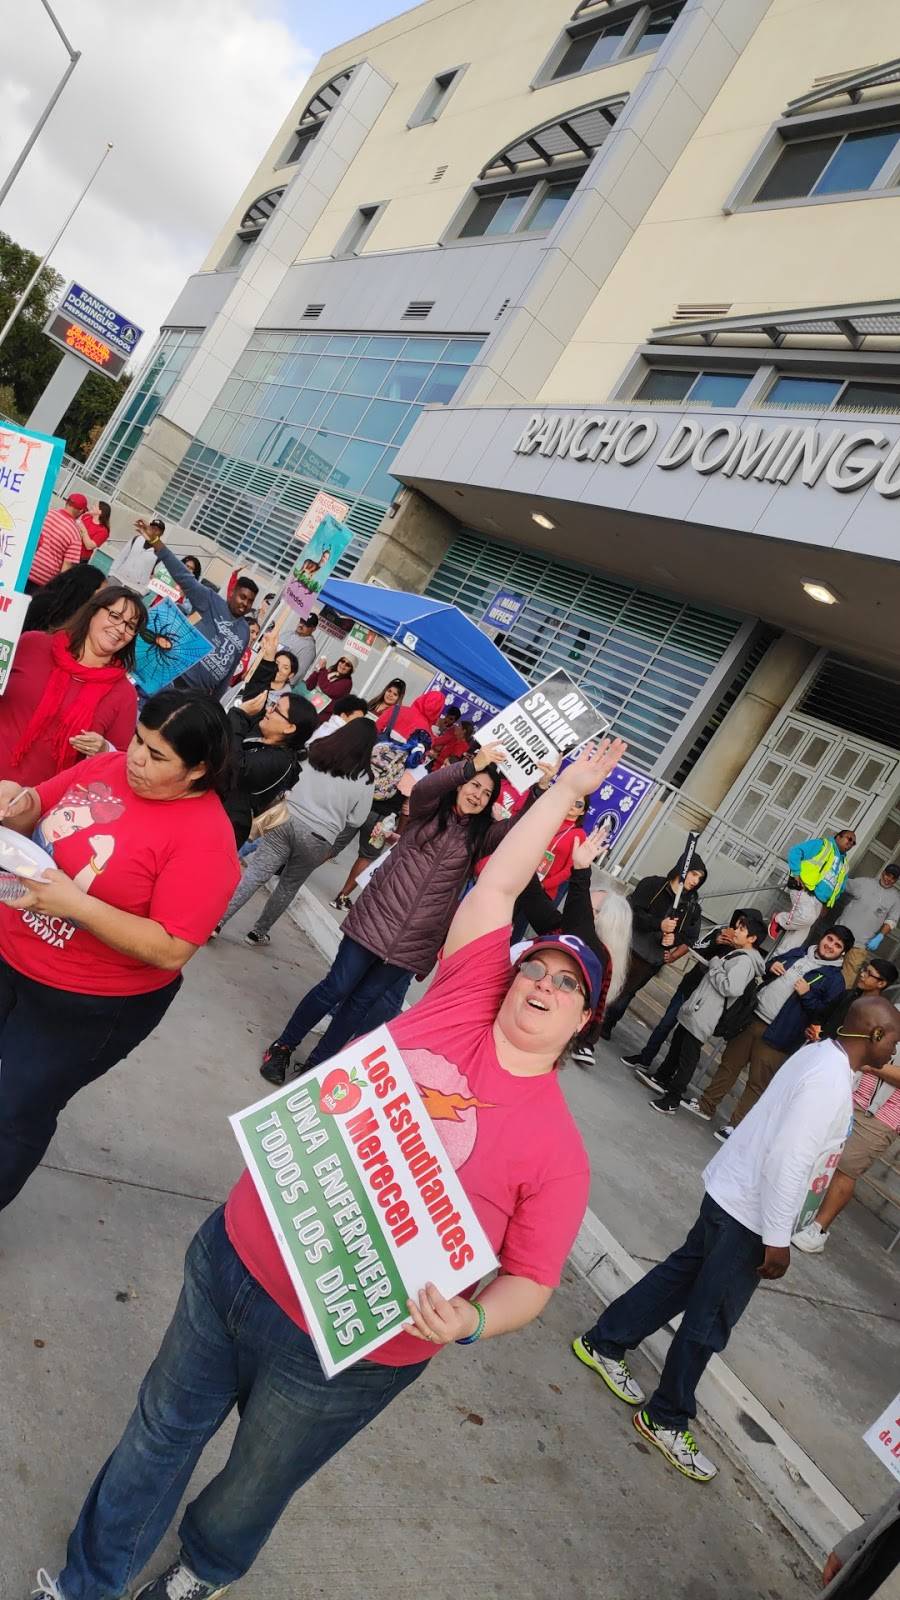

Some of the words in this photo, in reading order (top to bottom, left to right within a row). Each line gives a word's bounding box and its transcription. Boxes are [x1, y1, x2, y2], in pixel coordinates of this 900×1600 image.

[63, 302, 107, 334] PREPARATORY
[106, 332, 132, 353] SCHOOL
[67, 293, 120, 333] DOMINGUEZ
[80, 291, 116, 320] RANCHO
[513, 414, 658, 466] RANCHO
[0, 466, 25, 494] HE
[489, 607, 514, 625] OFFICE
[500, 598, 520, 612] MAIN
[524, 692, 580, 752] STRIKE
[557, 692, 588, 721] ON
[492, 722, 539, 776] STUDENTS
[509, 714, 533, 740] FOR
[526, 734, 550, 761] OUR
[624, 776, 646, 797] 12
[344, 1107, 420, 1249] Merecen
[360, 1045, 397, 1099] Los
[383, 1091, 475, 1271] Estudiantes
[254, 1111, 309, 1205] TODOS
[291, 1206, 334, 1266] LOS
[315, 1264, 366, 1347] DÍAS
[286, 1088, 330, 1155] UNA
[312, 1152, 402, 1331] ENFERMERA
